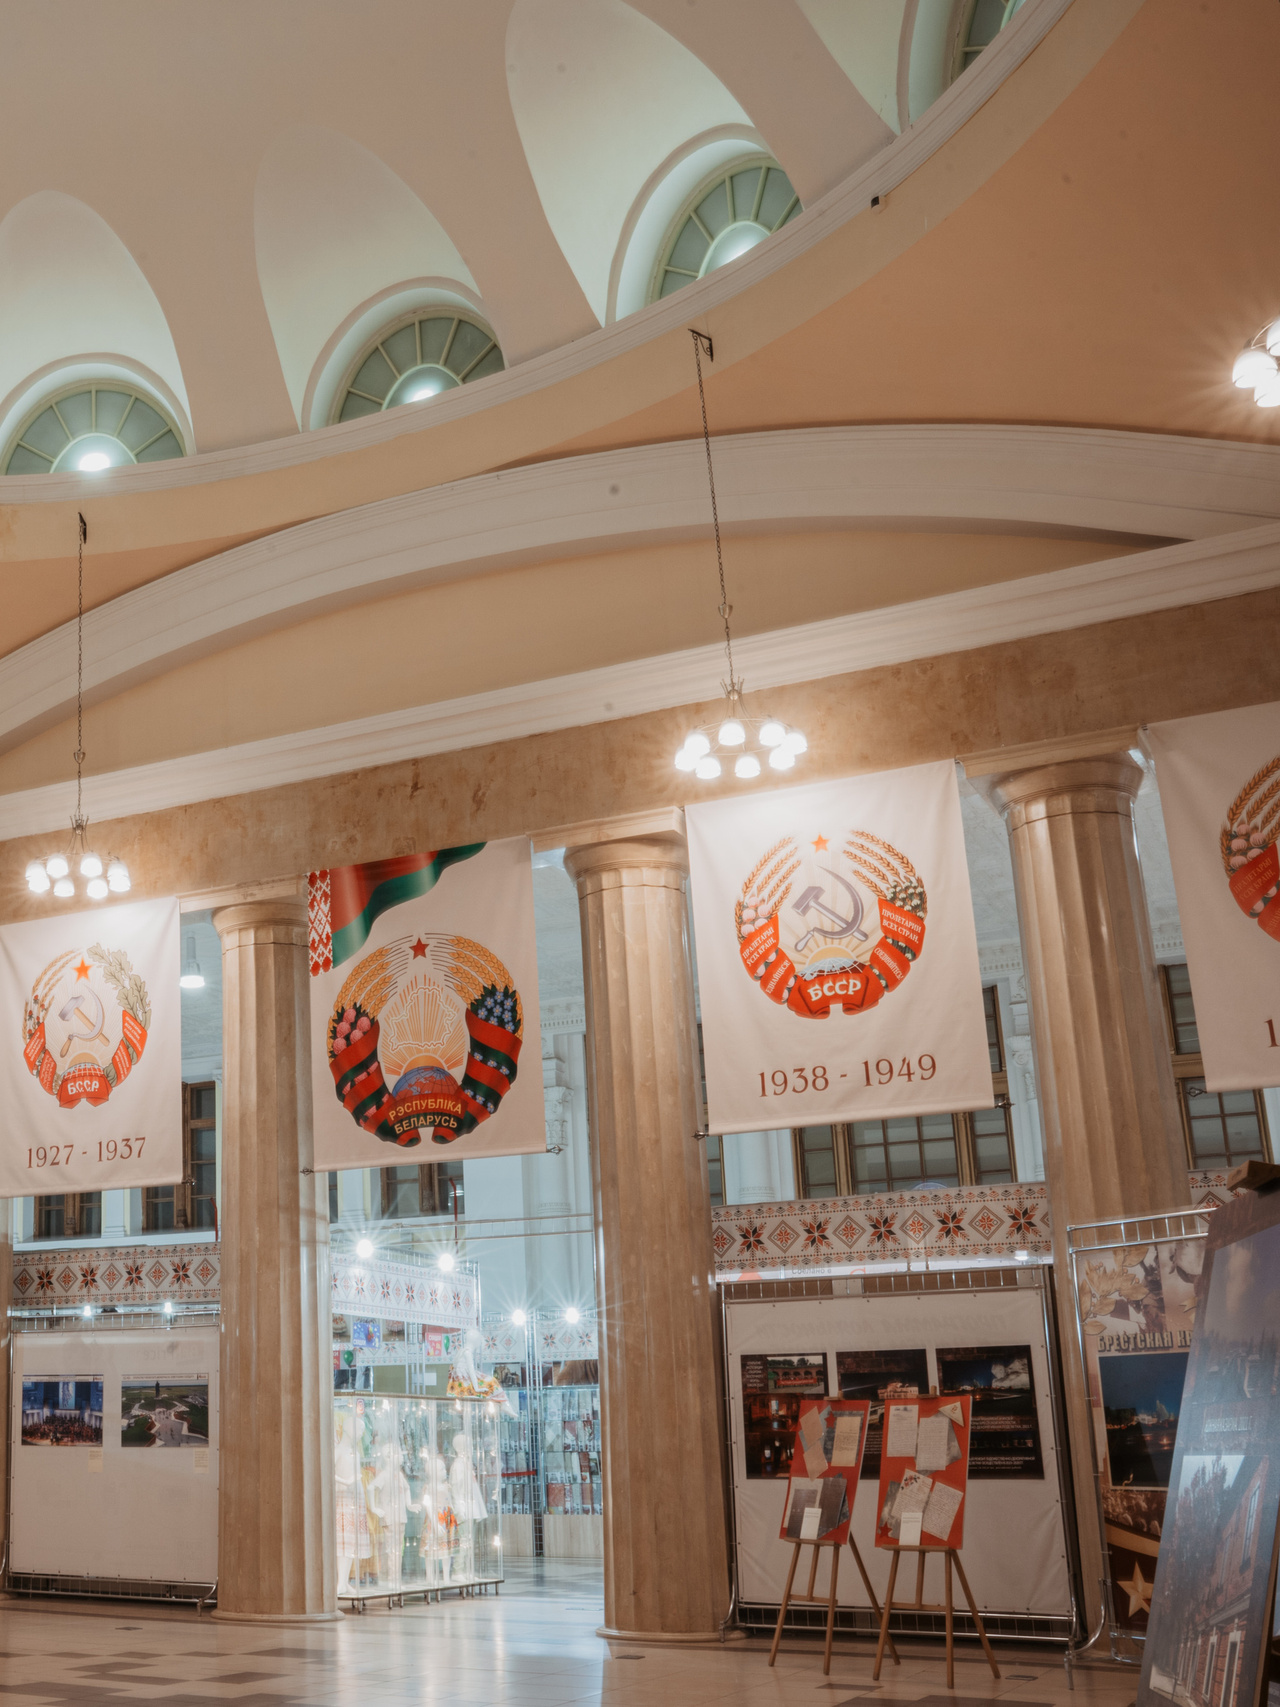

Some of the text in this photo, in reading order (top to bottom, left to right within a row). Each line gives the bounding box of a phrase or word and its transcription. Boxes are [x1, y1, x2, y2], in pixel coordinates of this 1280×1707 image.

[881, 908, 922, 934] ПРОЛЕТАРИИ
[882, 919, 898, 932] ВСЕХ
[807, 979, 862, 1002] БССР
[757, 1065, 830, 1098] 1938
[861, 1053, 937, 1087] 1949
[388, 1098, 462, 1121] РЭСПУБЛІКА
[394, 1115, 458, 1135] БЕЛАРУСЬ
[27, 1144, 74, 1169] 1927
[97, 1136, 146, 1163] 1937
[1098, 1331, 1174, 1352] БРЕСТСКАЯ
